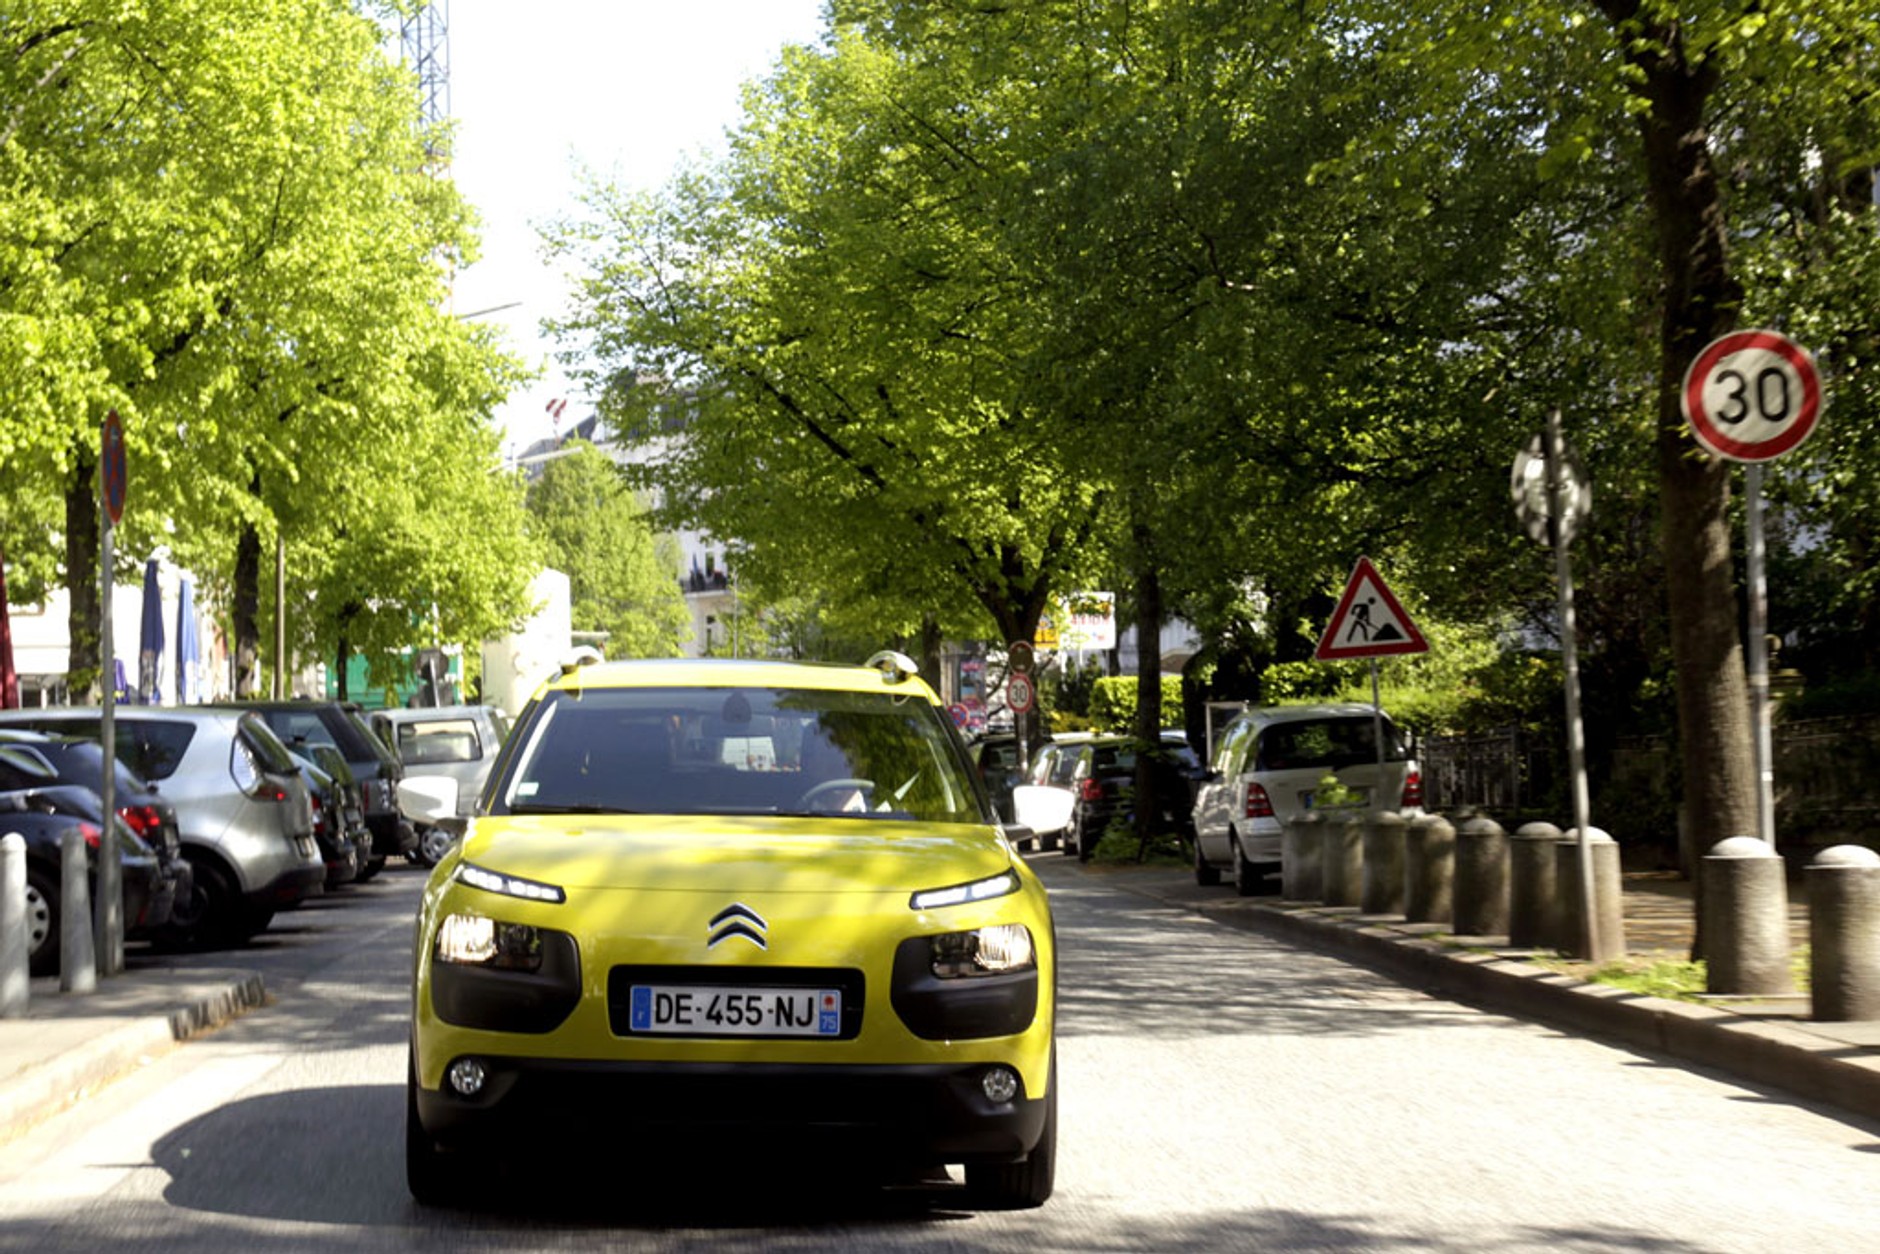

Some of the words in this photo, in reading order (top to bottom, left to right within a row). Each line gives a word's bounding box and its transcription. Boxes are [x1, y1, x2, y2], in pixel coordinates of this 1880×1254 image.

[1715, 367, 1789, 424] 30
[1011, 684, 1028, 703] 30
[655, 993, 814, 1028] DE-455-NJ
[822, 1015, 837, 1030] 75
